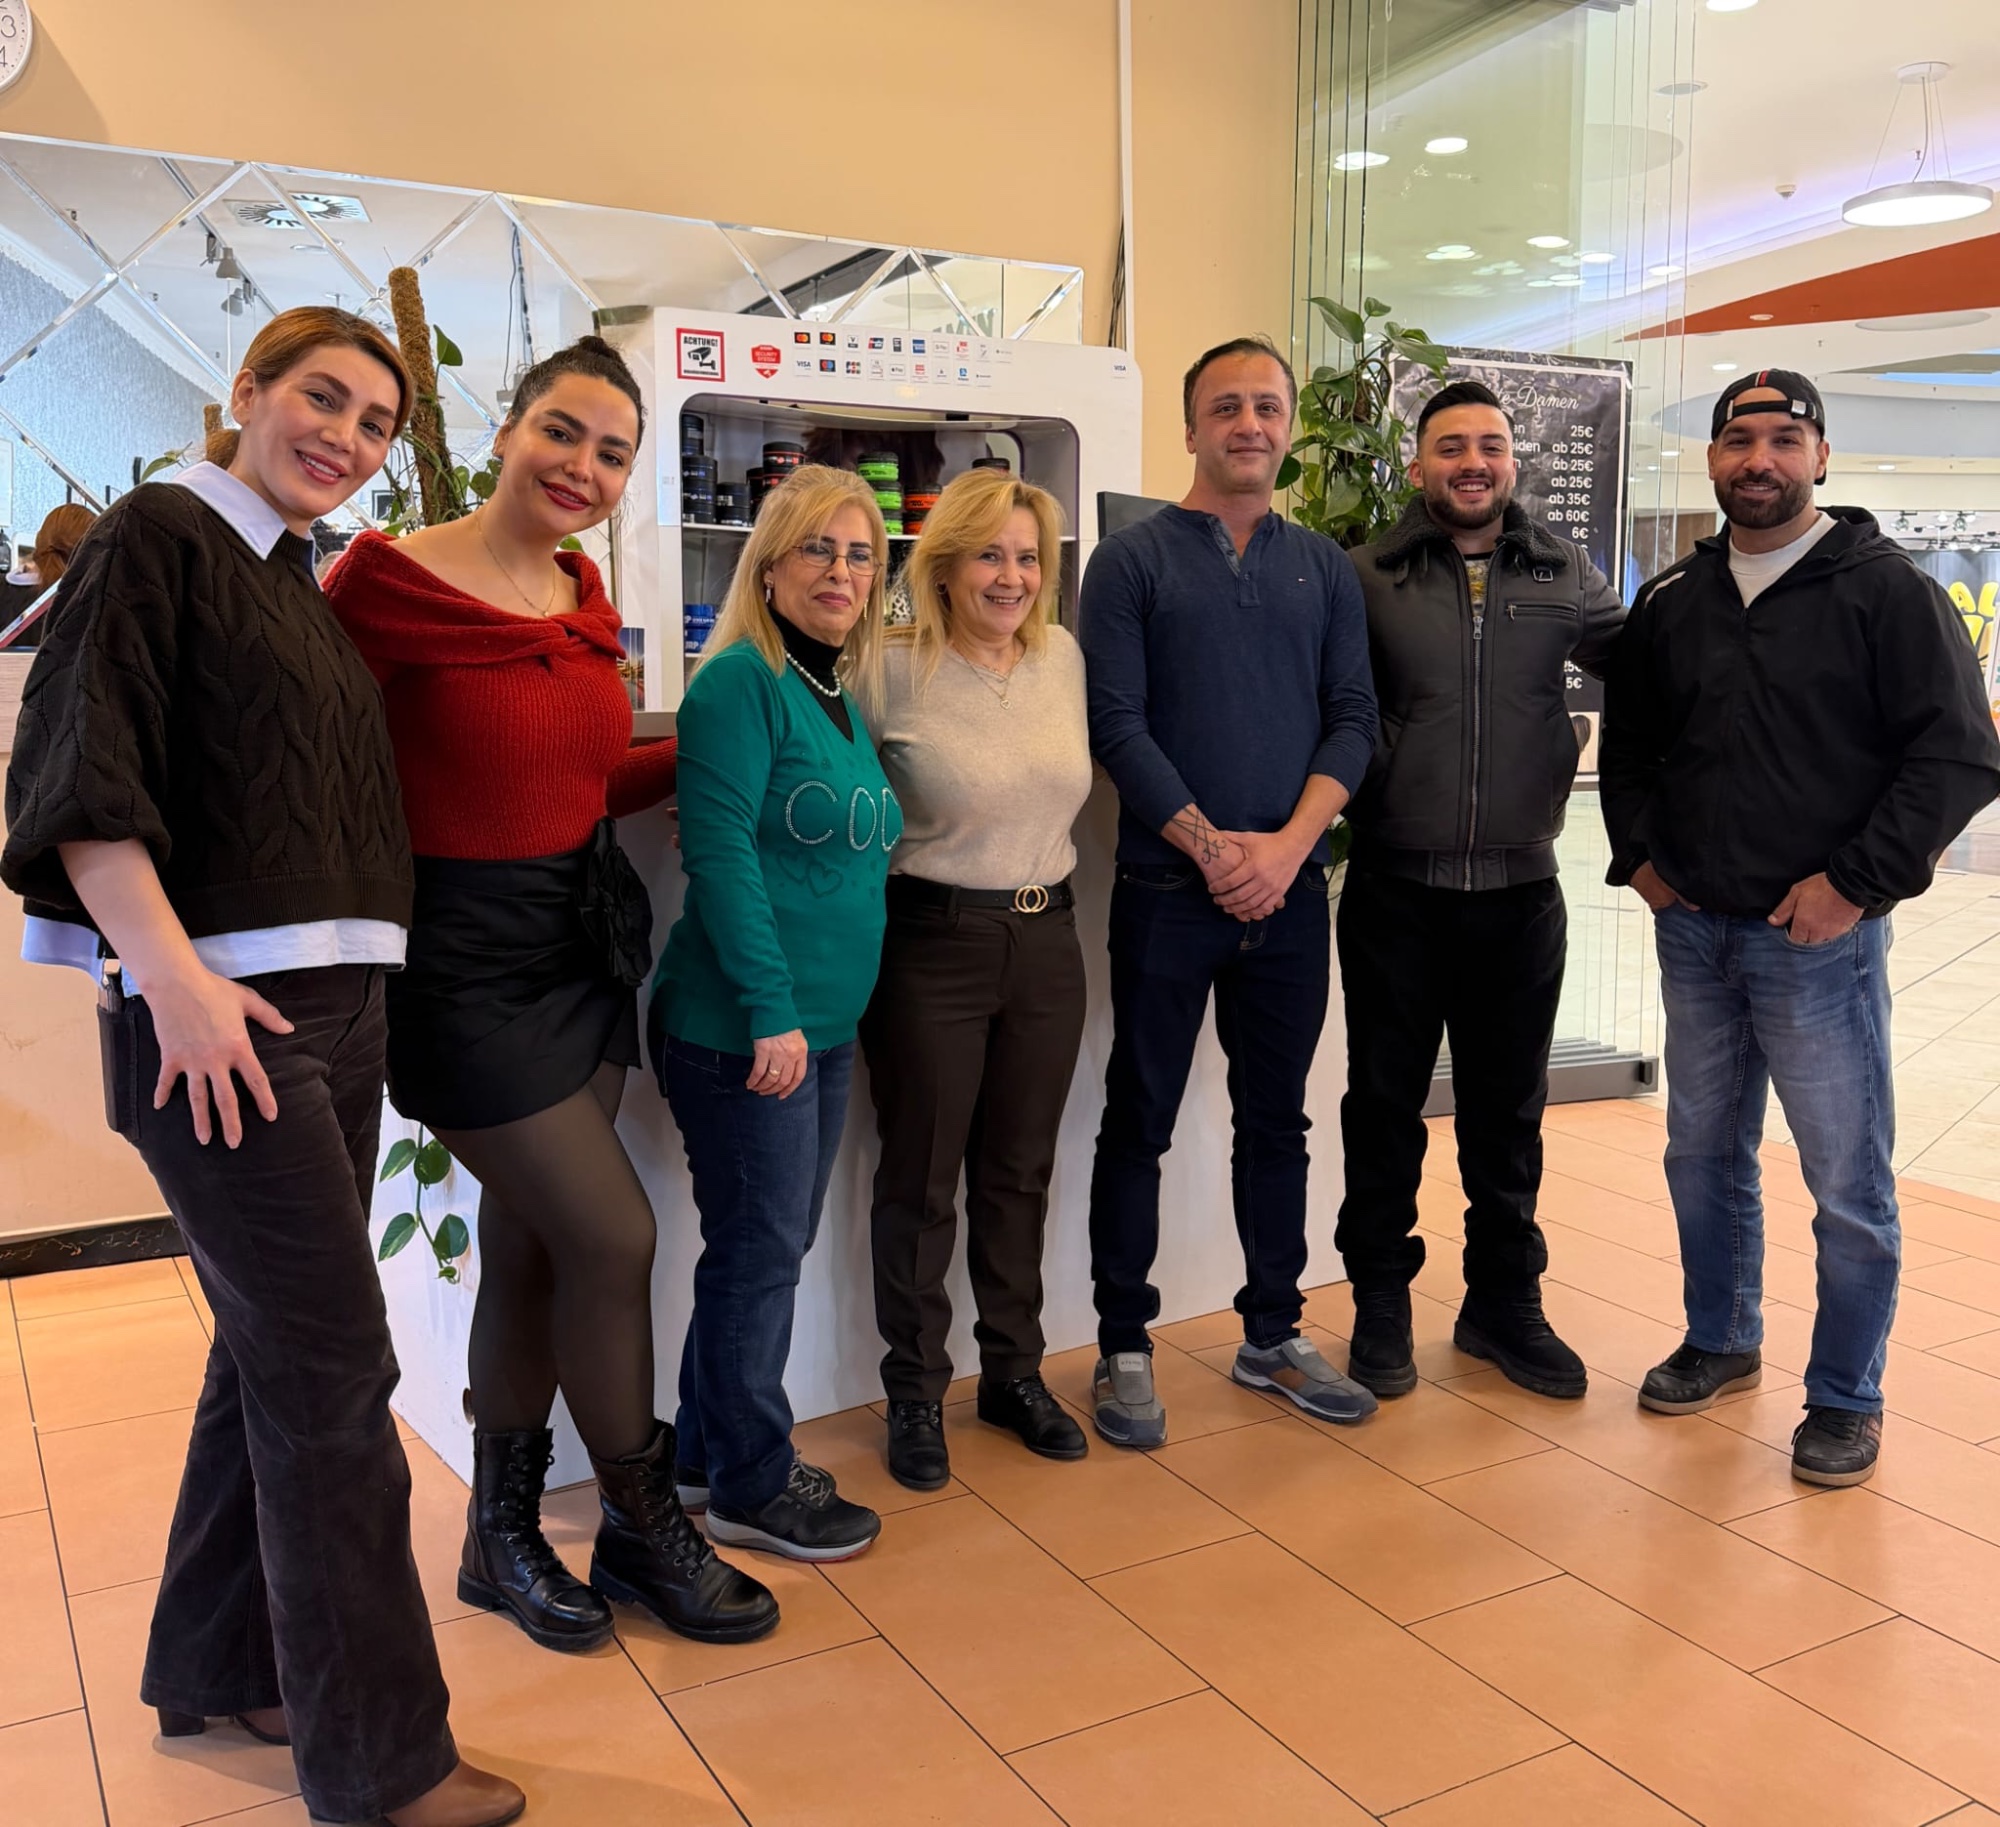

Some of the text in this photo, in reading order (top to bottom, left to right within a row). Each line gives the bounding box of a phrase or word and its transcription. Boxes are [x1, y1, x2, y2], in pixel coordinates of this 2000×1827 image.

[1, 15, 17, 38] 3
[683, 336, 718, 347] ACHTUNG!
[796, 360, 811, 368] VISA
[1517, 385, 1579, 410] Damen
[1570, 425, 1594, 438] 25€
[1552, 441, 1568, 454] ab
[1570, 442, 1594, 455] 25€
[1552, 459, 1594, 472] ab 25€
[1550, 475, 1593, 489] ab 25€
[1548, 492, 1591, 506] ab 35€
[1547, 509, 1590, 523] ab 60€
[1571, 526, 1589, 540] 6€
